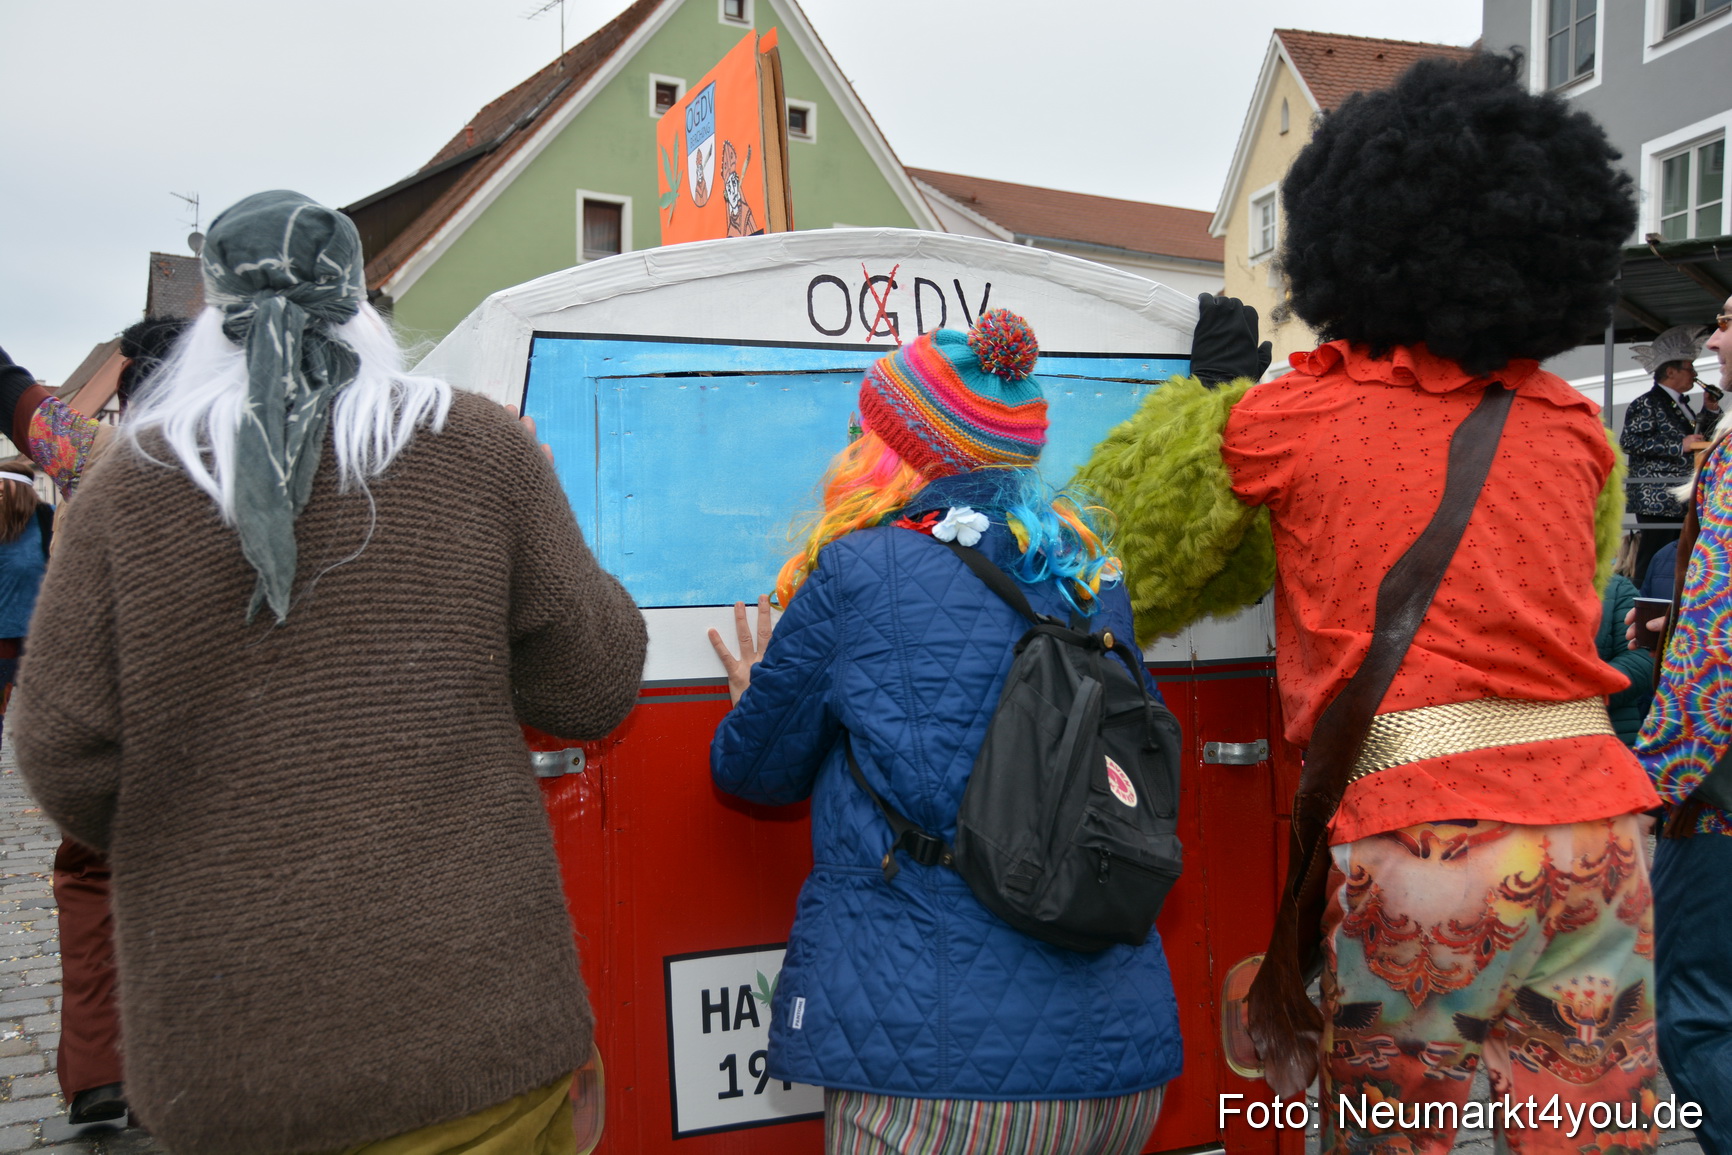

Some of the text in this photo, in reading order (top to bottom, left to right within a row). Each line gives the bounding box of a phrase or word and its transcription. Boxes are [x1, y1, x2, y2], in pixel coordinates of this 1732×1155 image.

[686, 86, 715, 133] OGDV
[807, 274, 992, 337] OGDV
[795, 1001, 804, 1027] PANTONE
[718, 1049, 792, 1100] 19
